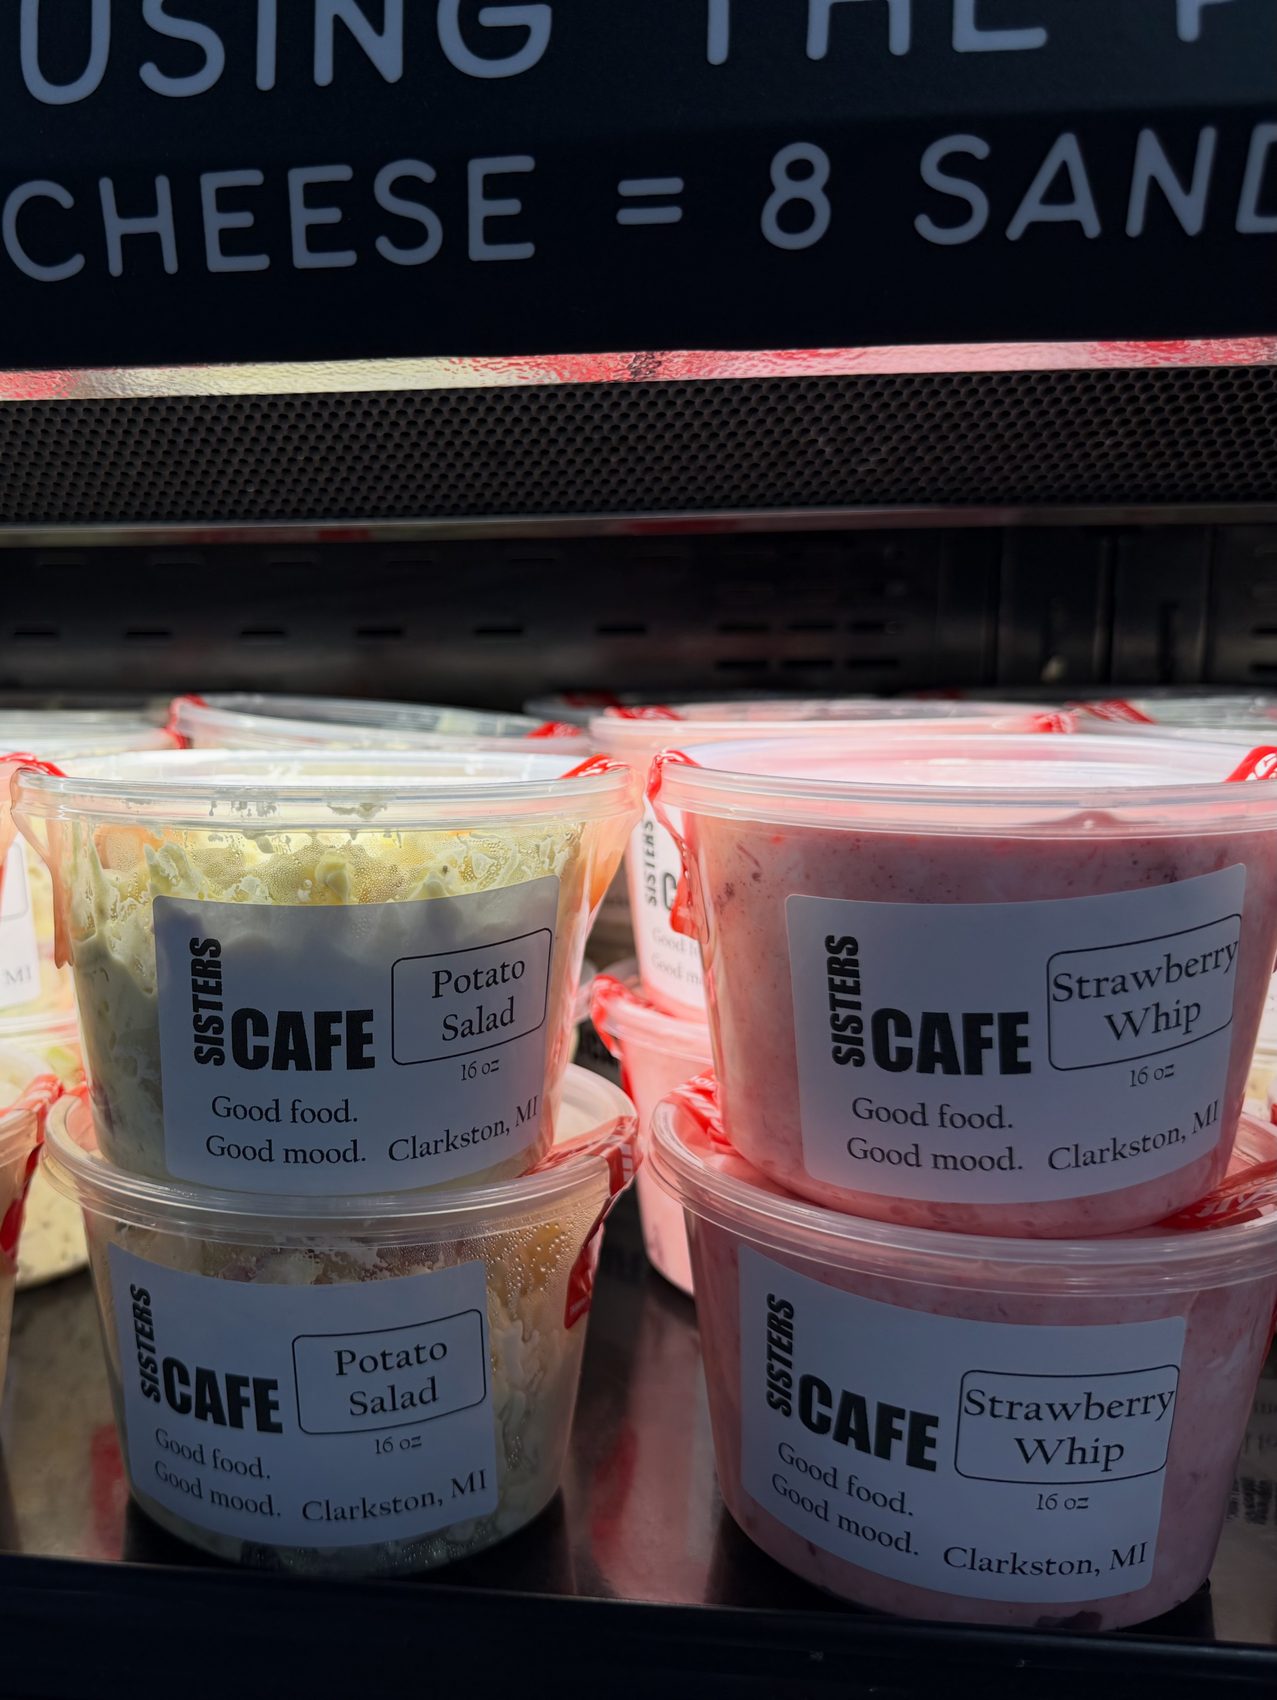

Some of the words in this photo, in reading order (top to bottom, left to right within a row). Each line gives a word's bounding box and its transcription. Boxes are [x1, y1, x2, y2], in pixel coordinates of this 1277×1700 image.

[19, 0, 551, 105] USING
[2, 155, 535, 282] CHEESE
[761, 142, 831, 250] 8
[431, 959, 526, 999] Potato
[1053, 939, 1239, 1002] Strawberry
[189, 937, 225, 1067] SISTERS
[441, 996, 516, 1041] Salad
[824, 934, 866, 1069] SISTERS
[1103, 997, 1203, 1044] Whip
[231, 1008, 376, 1071] CAFE
[870, 1007, 1032, 1076] CAFE
[460, 1061, 477, 1082] 16
[481, 1059, 500, 1076] oz
[1129, 1067, 1147, 1088] 16
[1152, 1063, 1175, 1081] oz
[211, 1096, 282, 1124] Good
[290, 1100, 359, 1125] food.
[388, 1120, 511, 1162] Clarkston,
[515, 1095, 539, 1122] MI
[852, 1097, 929, 1127] Good
[938, 1102, 1013, 1129] food.
[1048, 1127, 1187, 1171] Clarkston,
[1192, 1099, 1219, 1133] MI
[205, 1136, 275, 1164] Good
[283, 1142, 367, 1166] mood.
[846, 1137, 922, 1168] Good
[931, 1145, 1024, 1172] mood.
[130, 1283, 161, 1403] SISTERS
[333, 1340, 448, 1376] Potato
[766, 1292, 796, 1417] SISTERS
[162, 1356, 284, 1434] CAFE
[348, 1376, 439, 1417] Salad
[963, 1389, 1176, 1423] Strawberry
[374, 1435, 394, 1455] 16
[399, 1434, 422, 1449] oz
[798, 1374, 940, 1472] CAFE
[155, 1428, 206, 1467] Good
[211, 1448, 271, 1480] food.
[777, 1441, 839, 1490] Good
[846, 1472, 914, 1517] food.
[1014, 1437, 1126, 1472] Whip
[154, 1460, 204, 1500] Good
[209, 1487, 281, 1518] mood.
[301, 1488, 445, 1523] Clarkston,
[450, 1468, 488, 1500] MI
[771, 1472, 832, 1522] Good
[836, 1510, 920, 1556] mood.
[1036, 1493, 1057, 1512] 16
[1063, 1493, 1090, 1511] oz
[942, 1546, 1101, 1576] Clarkston,
[1108, 1541, 1148, 1570] MI
